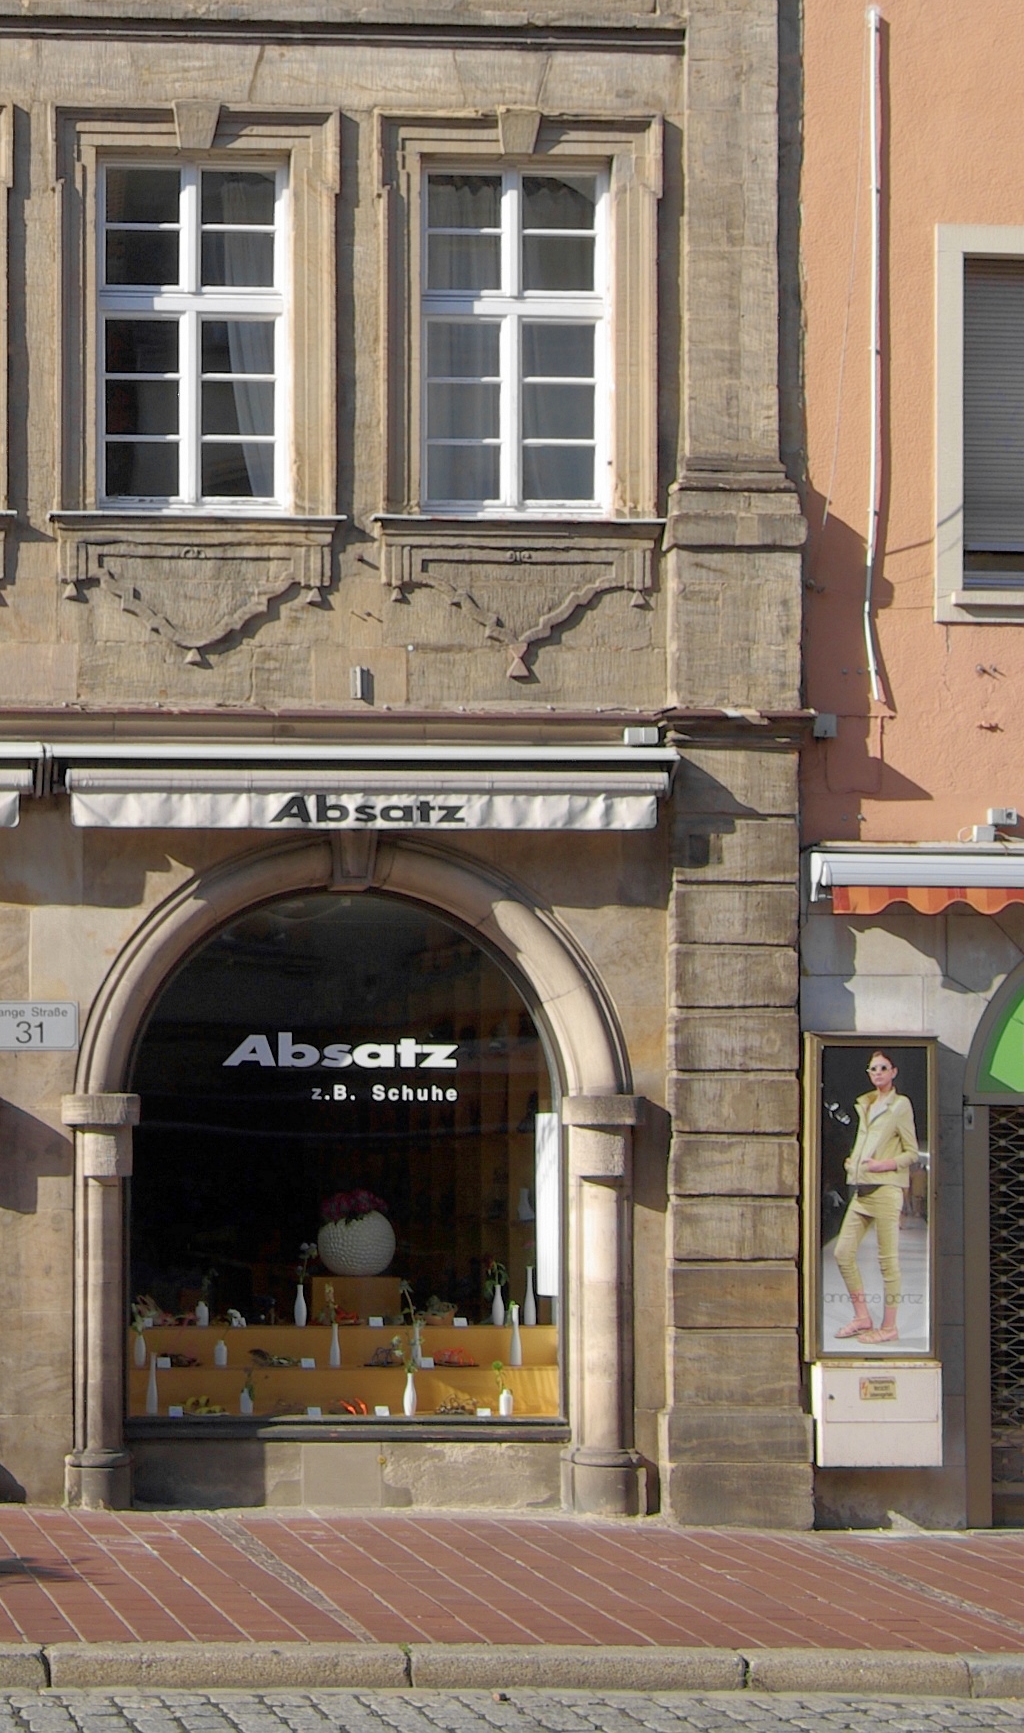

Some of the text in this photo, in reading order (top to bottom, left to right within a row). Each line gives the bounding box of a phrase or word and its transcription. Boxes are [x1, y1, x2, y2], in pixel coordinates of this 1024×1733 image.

[270, 794, 465, 824] Absatz
[31, 1007, 68, 1018] Straße
[15, 1021, 44, 1044] 31
[222, 1031, 459, 1069] Absatz
[311, 1084, 458, 1102] z.B. Schuhe
[824, 1293, 882, 1304] annette
